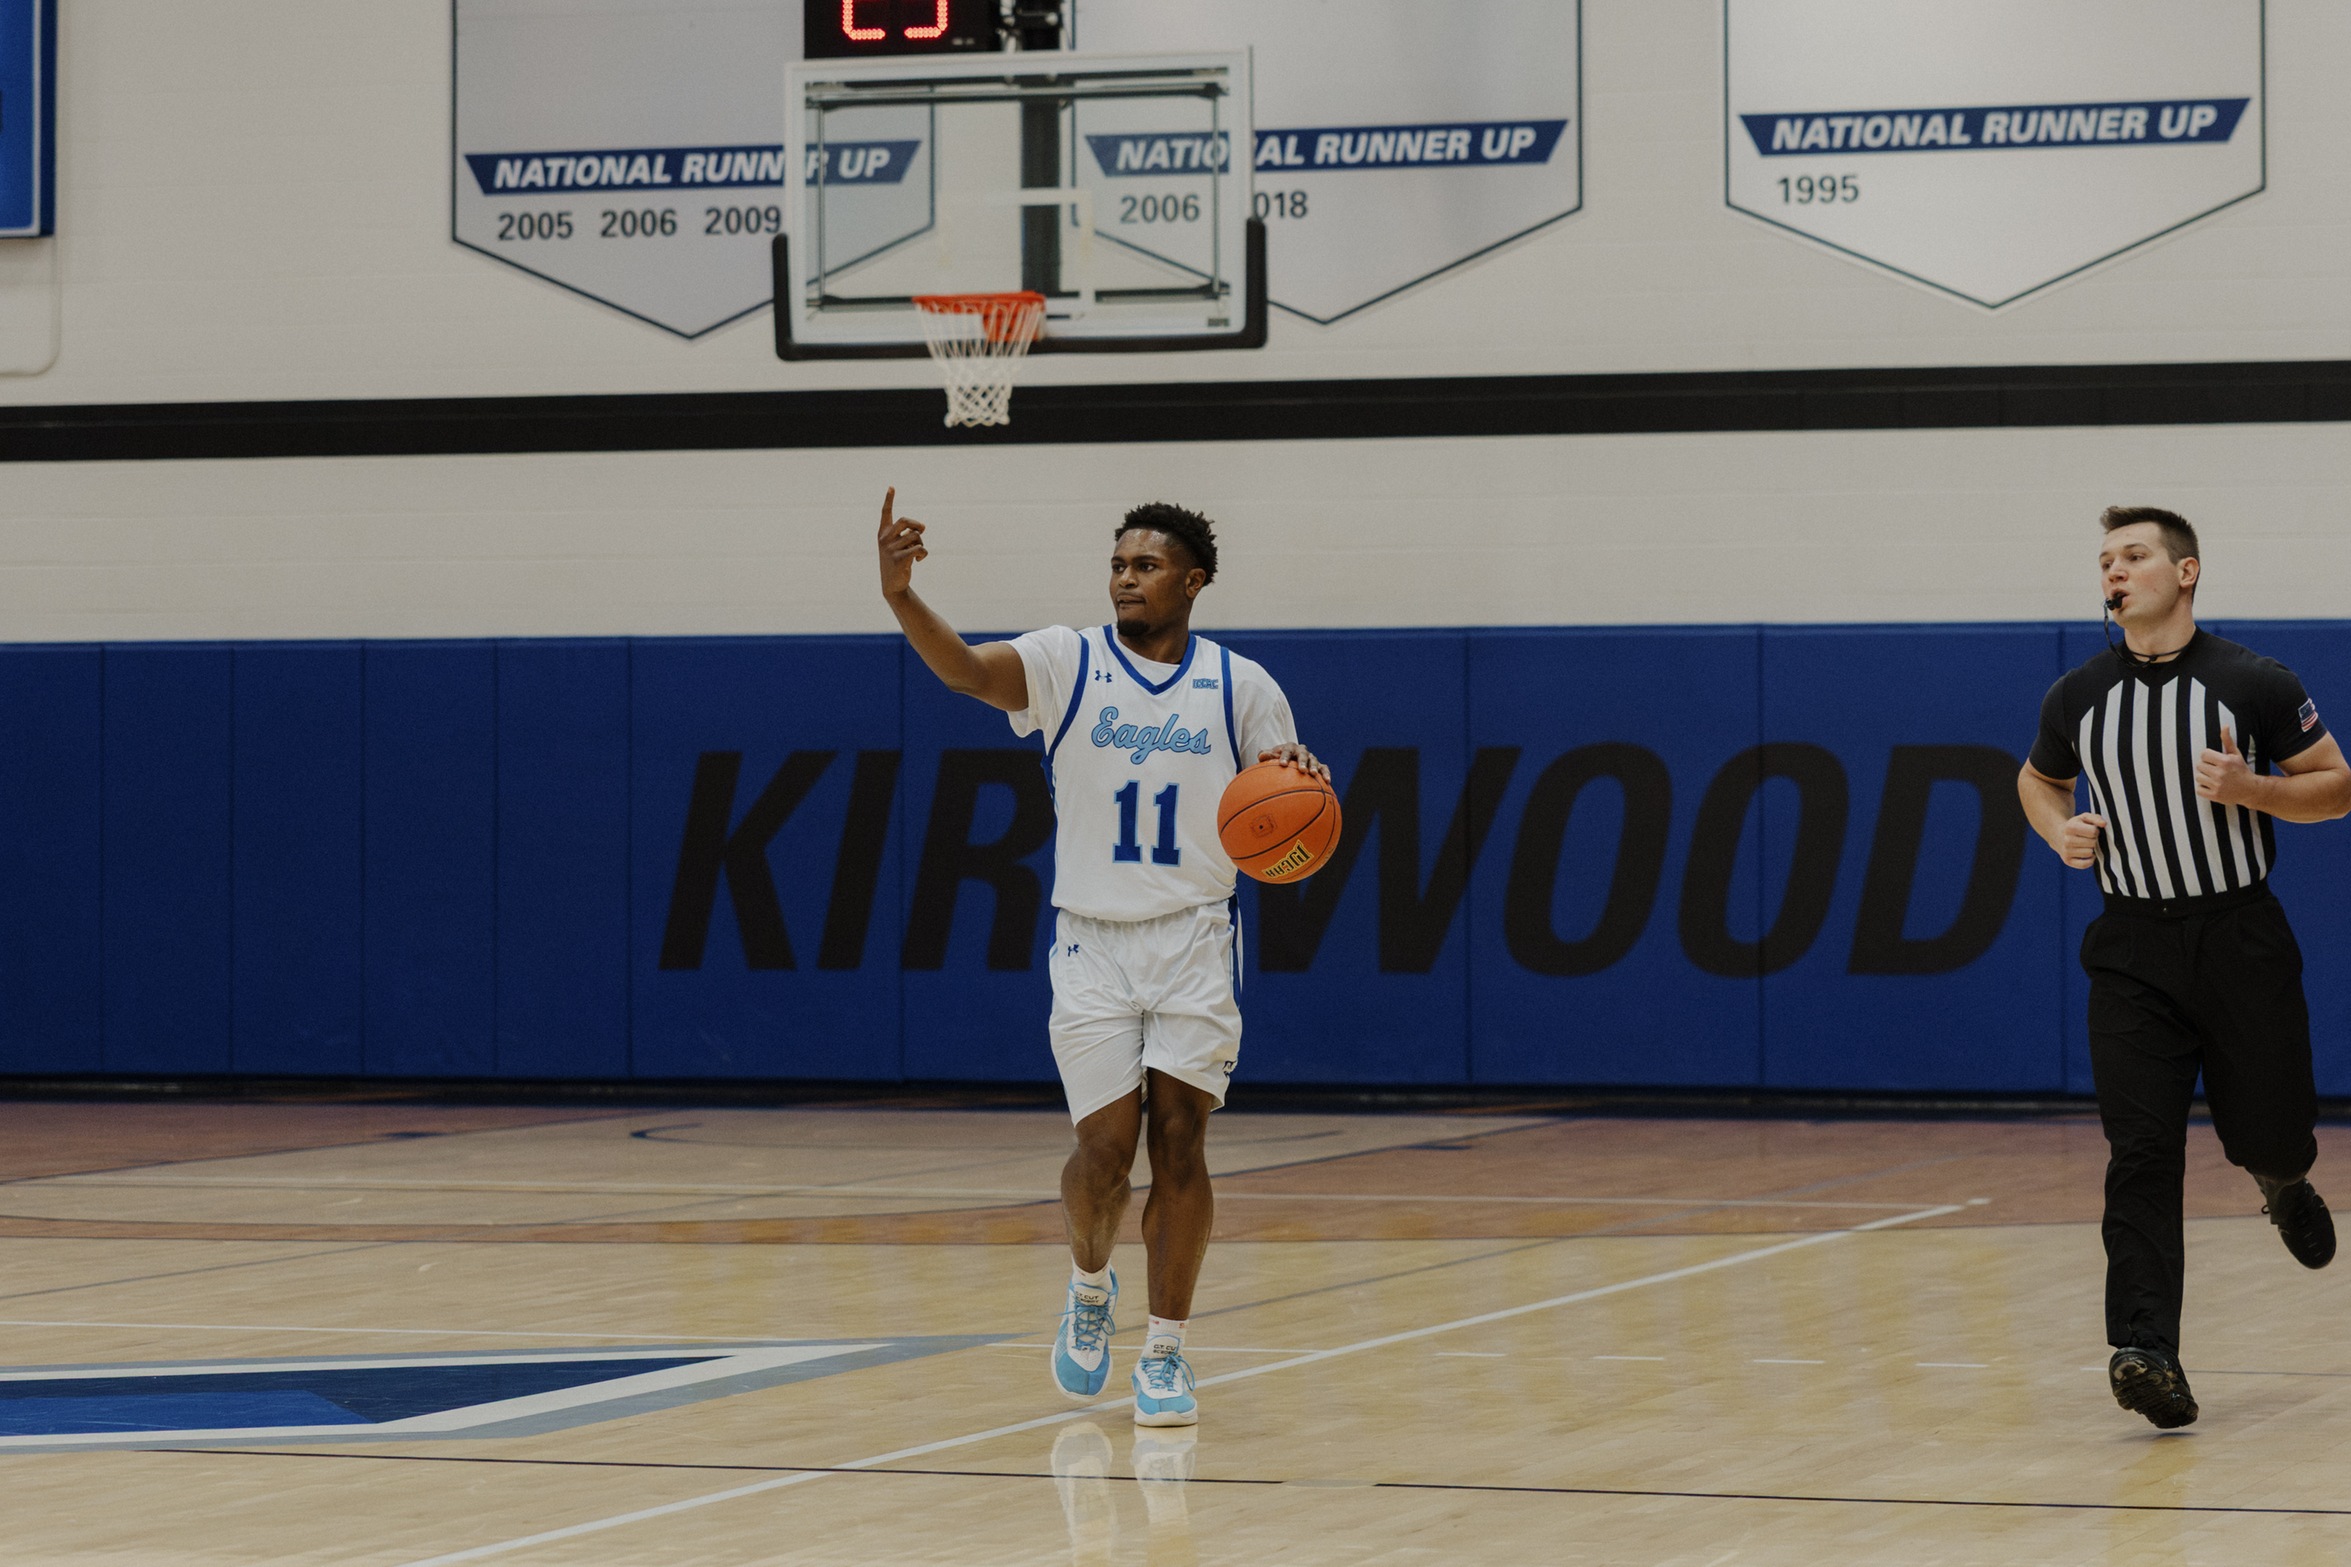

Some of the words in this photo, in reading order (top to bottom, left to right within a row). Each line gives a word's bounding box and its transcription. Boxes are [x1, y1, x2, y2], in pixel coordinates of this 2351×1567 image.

[1116, 134, 1304, 171] NATIOAL
[1313, 130, 1471, 165] RUNNER
[1481, 126, 1537, 160] UP
[1771, 112, 1971, 151] NATIONAL
[1981, 108, 2149, 145] RUNNER
[2158, 104, 2219, 139] UP
[494, 153, 672, 189] NATIONAL
[681, 150, 830, 184] RUNNR
[838, 147, 891, 179] UP
[1776, 174, 1860, 206] 1995
[497, 210, 574, 241] 2005
[600, 207, 679, 239] 2006
[704, 205, 783, 236] 2009
[1119, 193, 1201, 225] 2006
[1253, 190, 1308, 220] 018
[1091, 705, 1212, 766] Eagles
[1111, 779, 1182, 868] 11
[658, 741, 2028, 977] KIRWOOD
